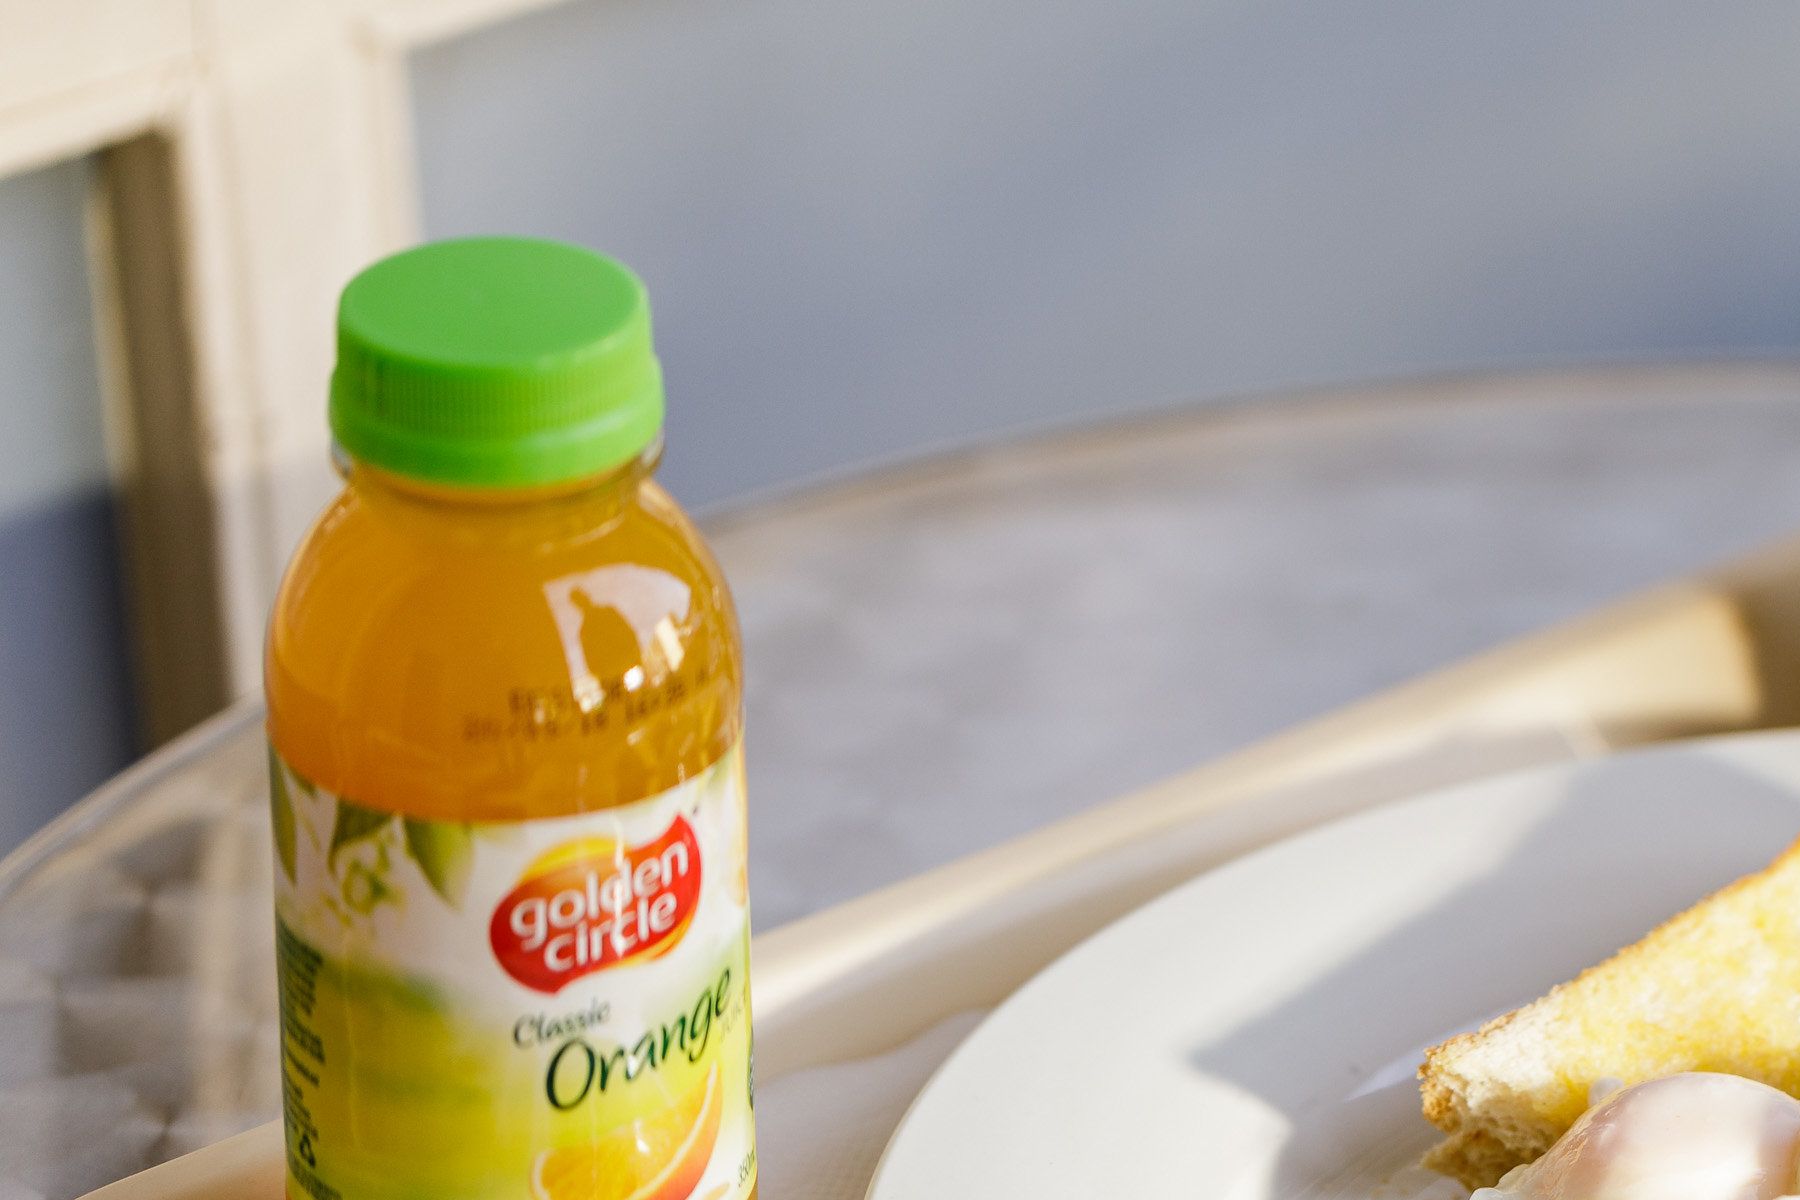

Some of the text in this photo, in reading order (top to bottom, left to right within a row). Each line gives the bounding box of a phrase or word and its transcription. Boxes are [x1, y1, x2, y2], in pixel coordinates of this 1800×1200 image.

[510, 842, 689, 951] golden
[544, 893, 677, 972] circle
[513, 998, 611, 1047] Classic
[546, 967, 730, 1111] Orange
